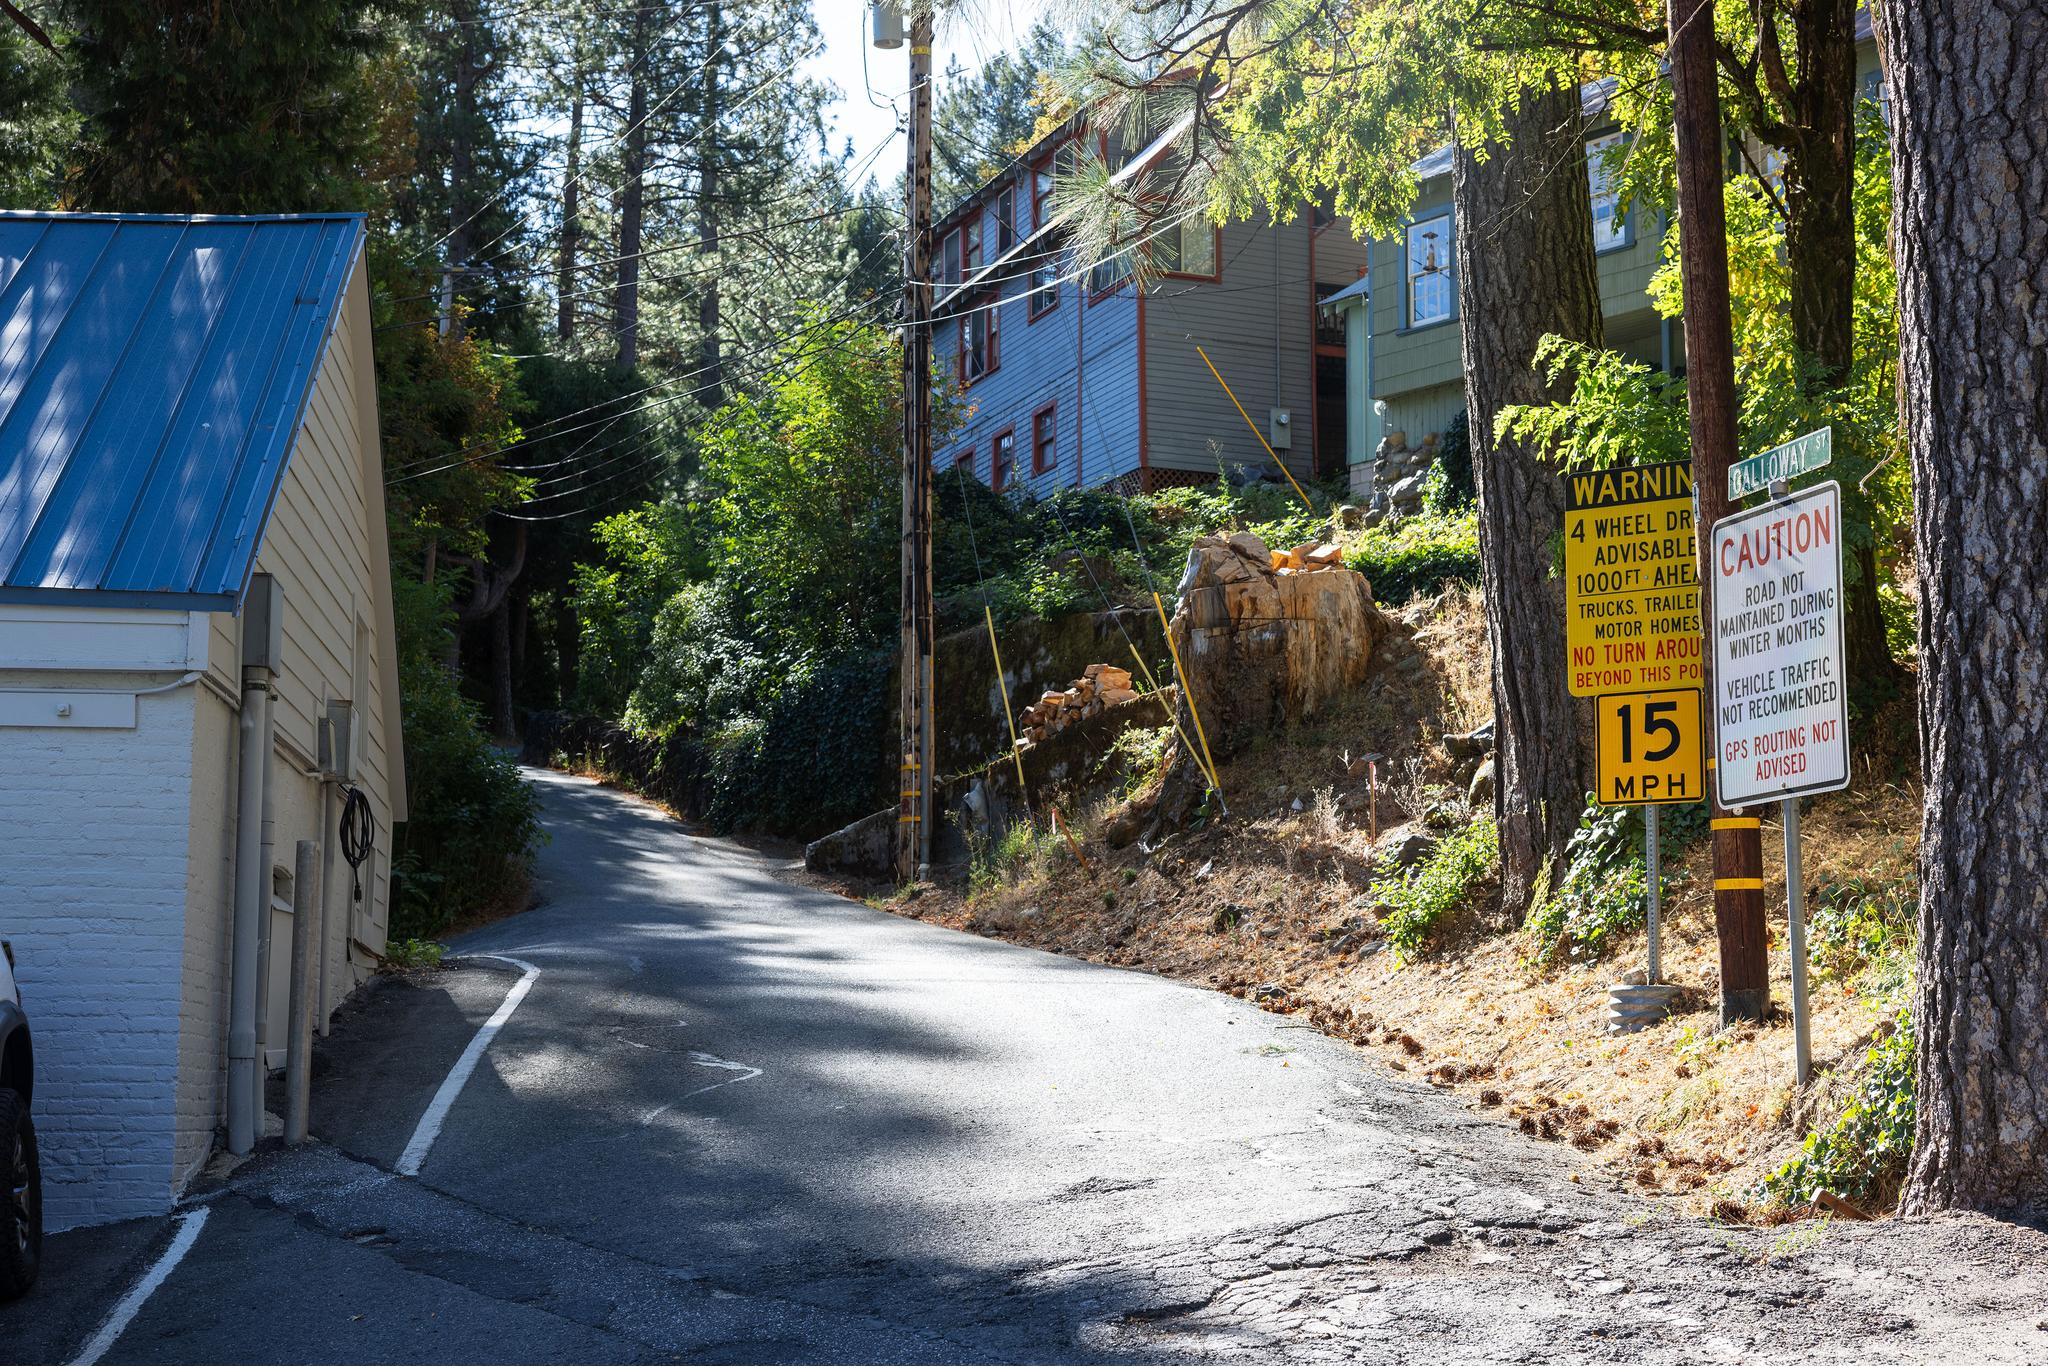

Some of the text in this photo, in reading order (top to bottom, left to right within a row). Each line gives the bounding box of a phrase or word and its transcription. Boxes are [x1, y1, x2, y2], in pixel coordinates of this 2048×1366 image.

[1733, 433, 1826, 494] GALLOWAY ST
[1573, 463, 1694, 506] WARNIN
[1571, 509, 1695, 543] 4 WHEEL DR
[1721, 505, 1831, 577] CAUTION
[1594, 536, 1697, 566] ADVISABLE
[1577, 569, 1641, 594] 1000FT
[1745, 571, 1805, 607] ROAD NOT
[1645, 593, 1698, 613] TRAILE
[1720, 588, 1834, 638] MAINTAINED DURING
[1595, 615, 1700, 640] MOTOR HOMES
[1729, 616, 1826, 660] WINTER MONTHS
[1573, 637, 1700, 667] NO TURN AROU
[1576, 663, 1703, 688] BEYOND THIS POI
[1727, 656, 1830, 700] VEHICLE TRAFFIC
[1722, 681, 1837, 726] NOT RECOMMENDED
[1617, 701, 1681, 763] 15
[1725, 720, 1837, 762] GPS ROUTING NOT
[1756, 752, 1806, 781] ADVISED
[1614, 773, 1686, 799] MPH
